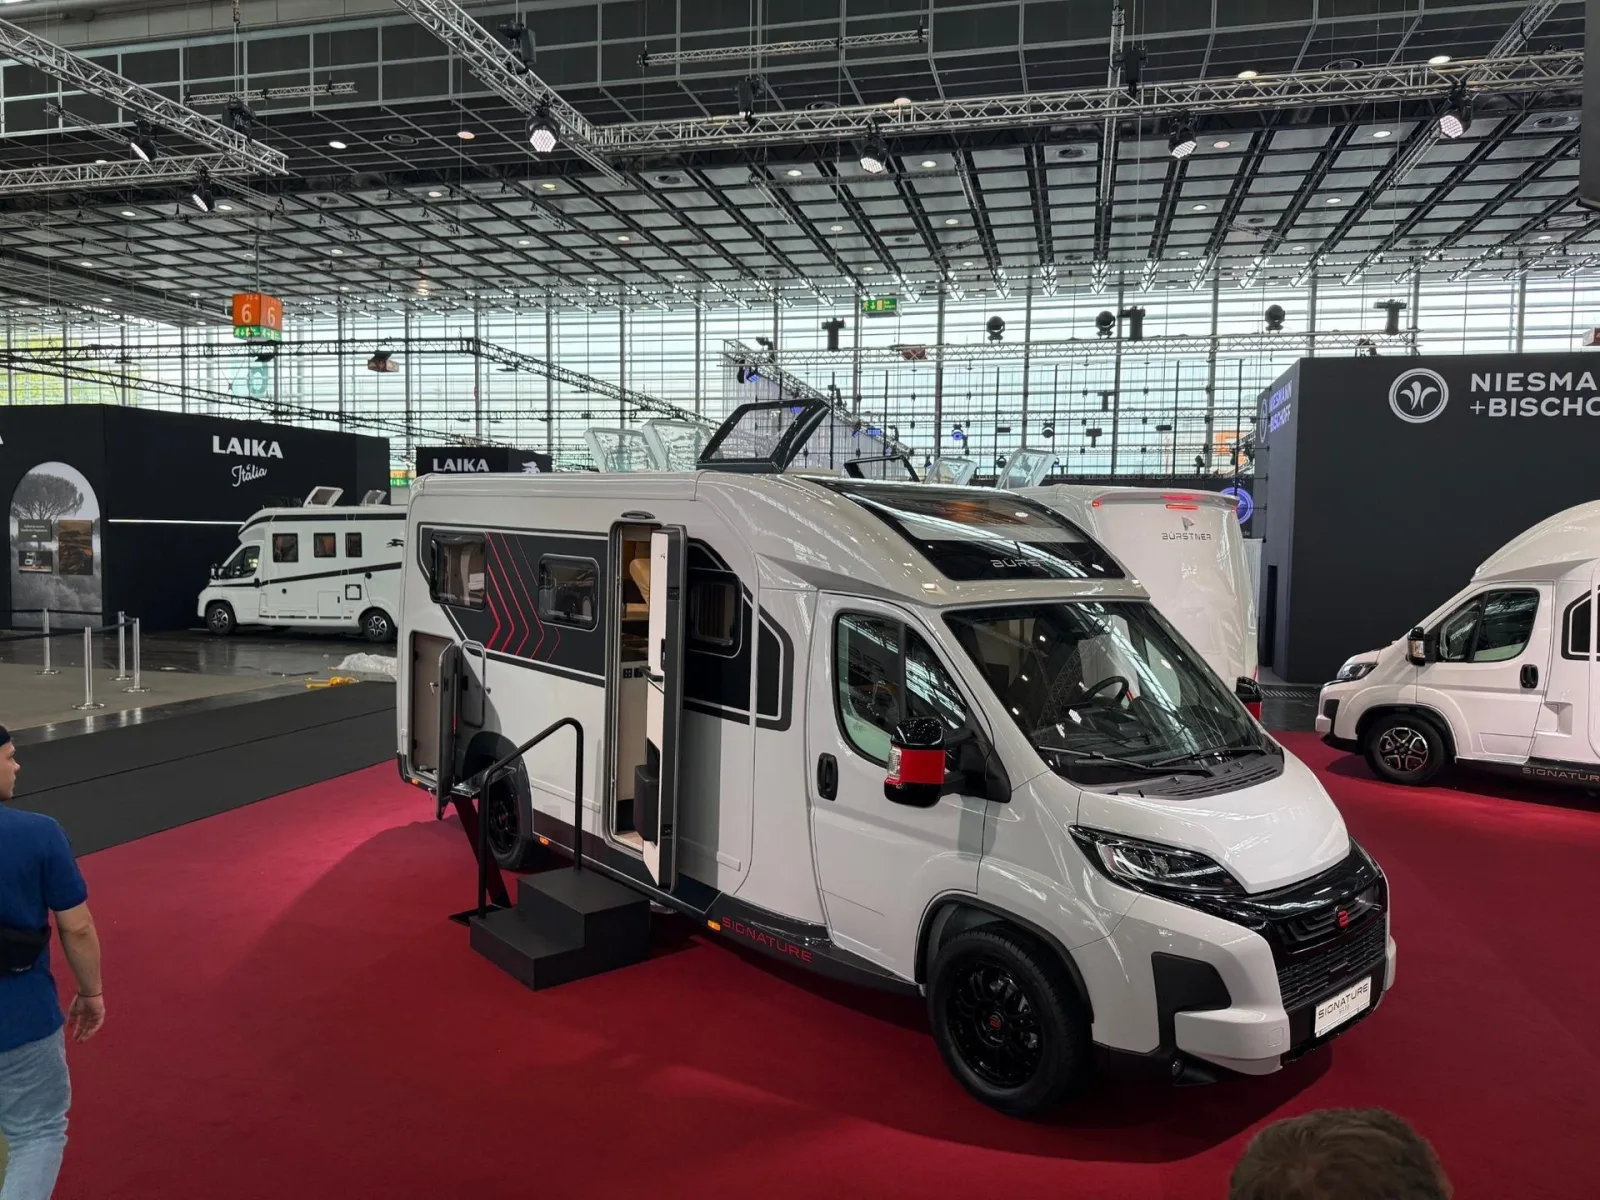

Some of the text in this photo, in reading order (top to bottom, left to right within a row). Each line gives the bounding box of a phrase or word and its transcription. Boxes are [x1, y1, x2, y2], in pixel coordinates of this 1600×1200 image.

[241, 303, 252, 323] 6
[267, 307, 276, 327] 6
[1470, 371, 1598, 393] NIESMA
[1469, 396, 1600, 417] +BISCHO
[212, 434, 284, 460] LAIKA
[432, 457, 490, 473] LAIKA
[1161, 531, 1212, 541] BÜRSTNER
[990, 557, 1085, 569] BÜRSR
[1522, 767, 1600, 782] SIGNATUR
[721, 916, 813, 963] SIGNATURE
[1318, 983, 1369, 1020] SIGNATURE
